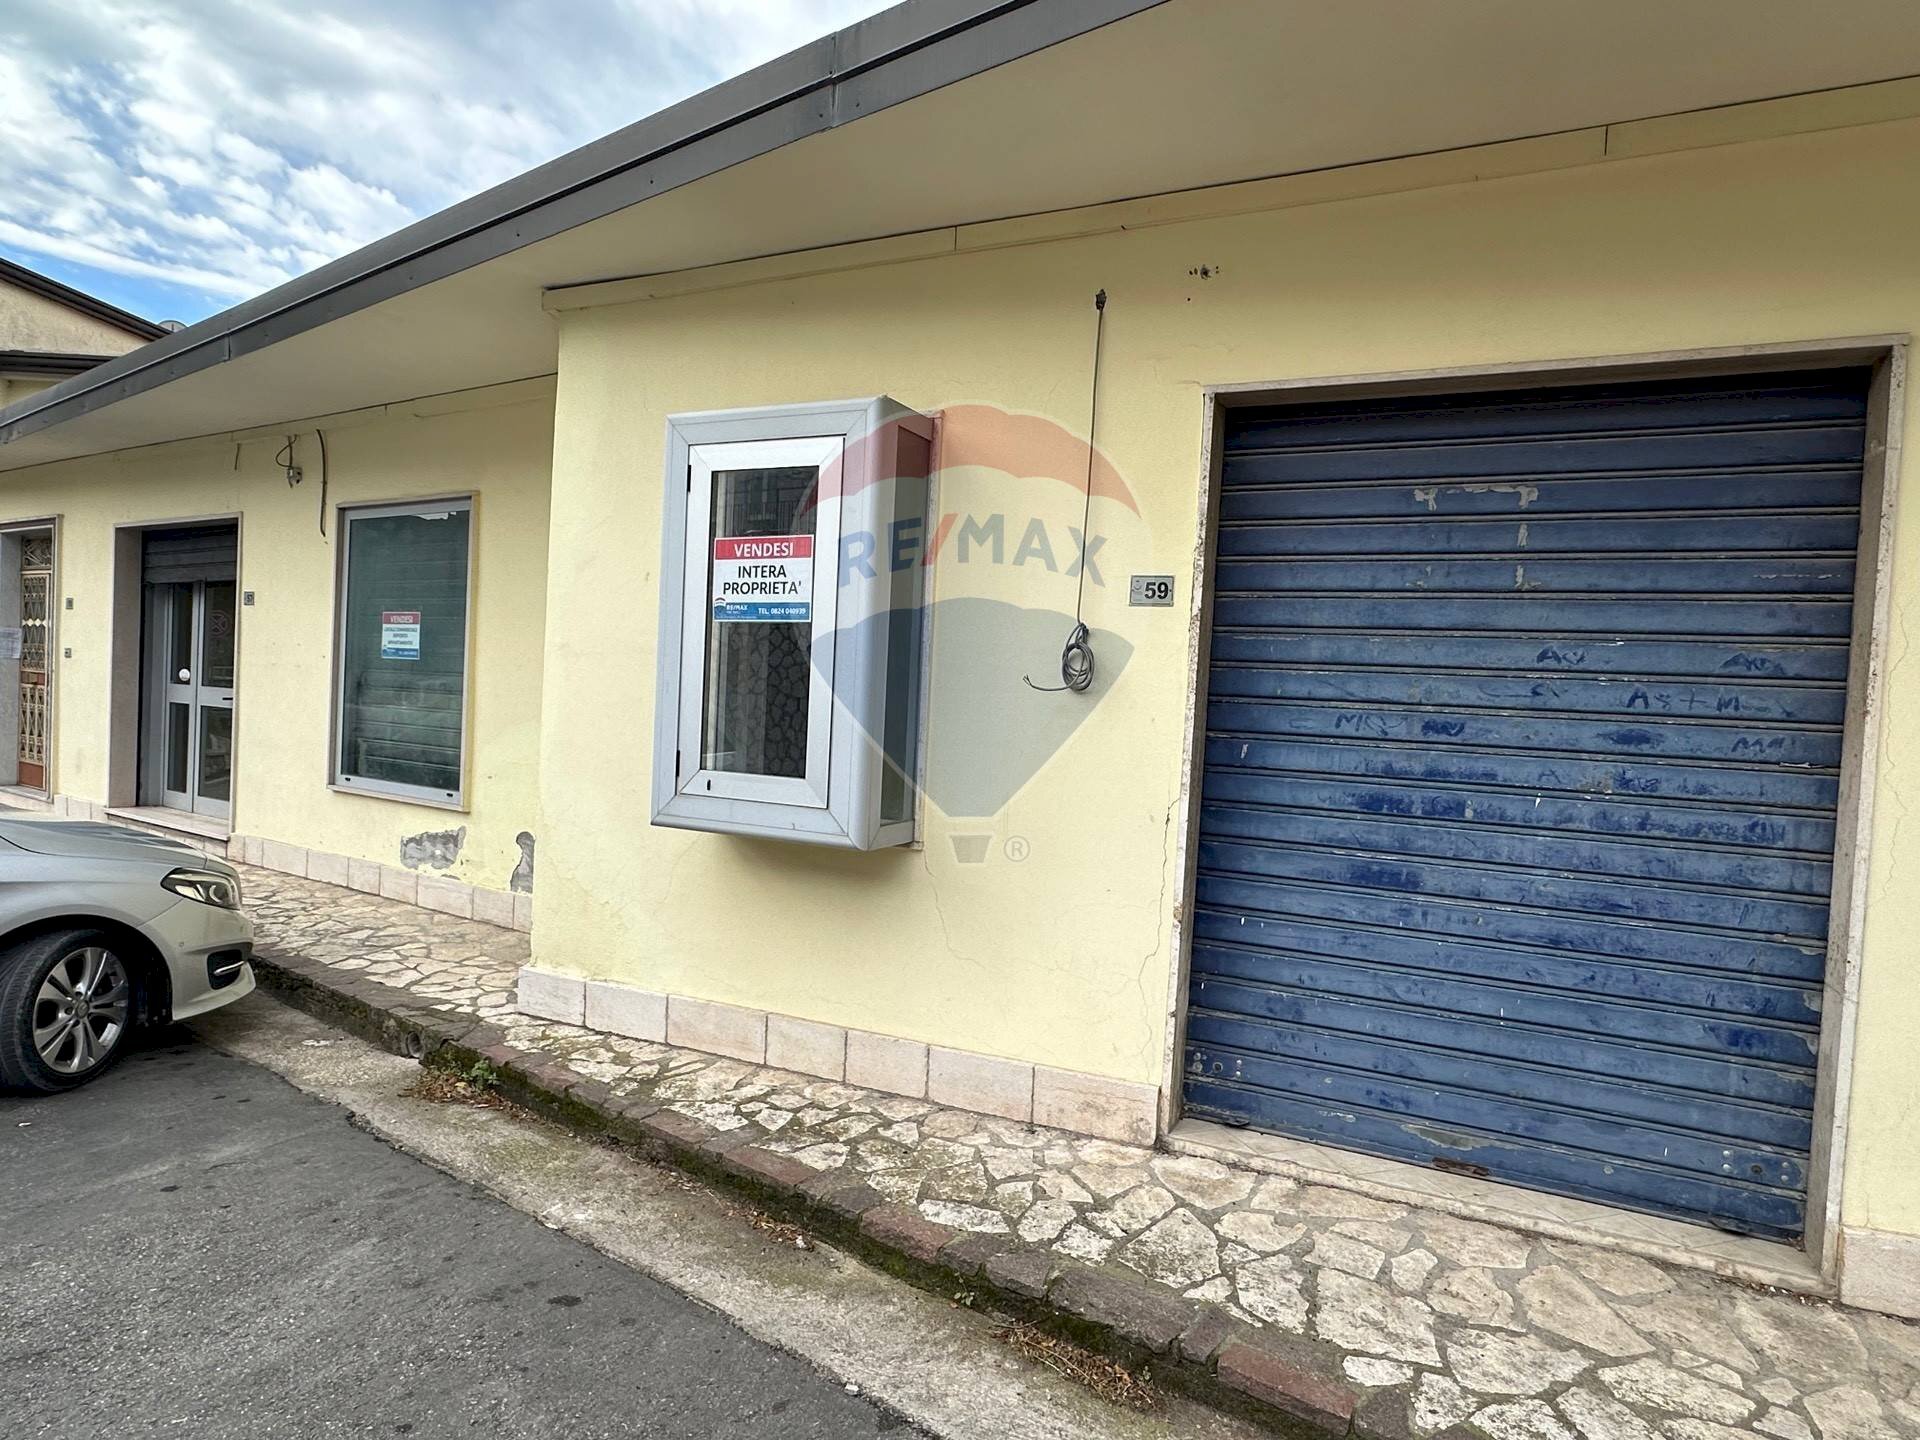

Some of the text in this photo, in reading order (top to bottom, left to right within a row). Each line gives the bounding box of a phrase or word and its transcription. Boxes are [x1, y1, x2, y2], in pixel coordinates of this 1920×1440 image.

[734, 542, 794, 557] VENDESI
[738, 565, 787, 579] INTERA
[723, 580, 802, 595] PROPRIETA'
[1144, 581, 1169, 600] 59
